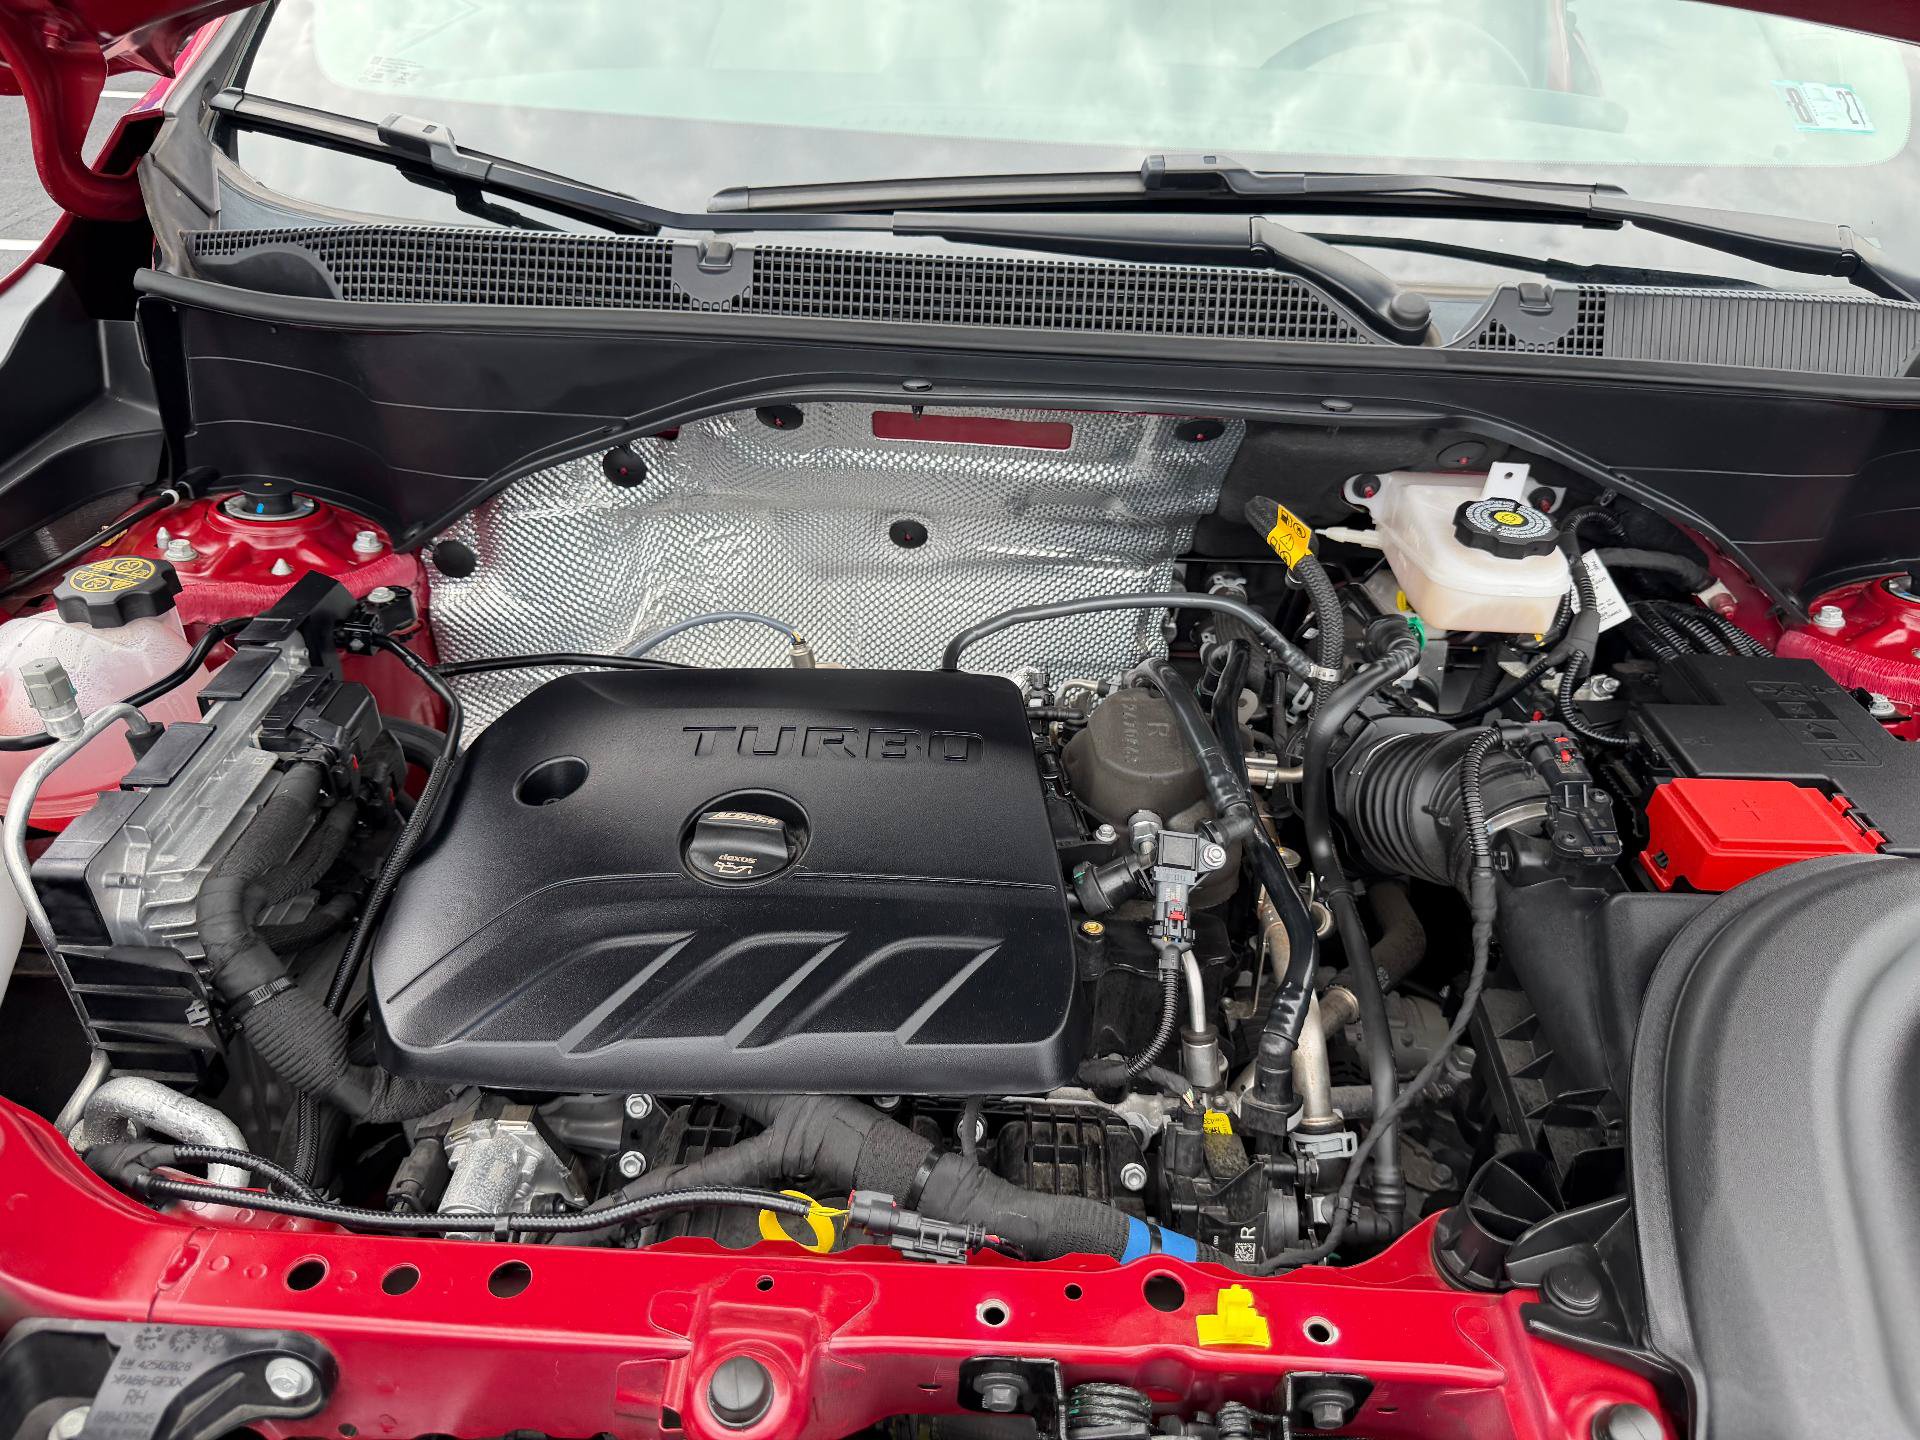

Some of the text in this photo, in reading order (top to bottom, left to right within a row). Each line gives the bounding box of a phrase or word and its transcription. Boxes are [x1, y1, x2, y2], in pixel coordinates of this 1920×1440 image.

[682, 725, 985, 762] TURBO
[718, 853, 758, 864] dexos
[122, 1388, 149, 1405] RH
